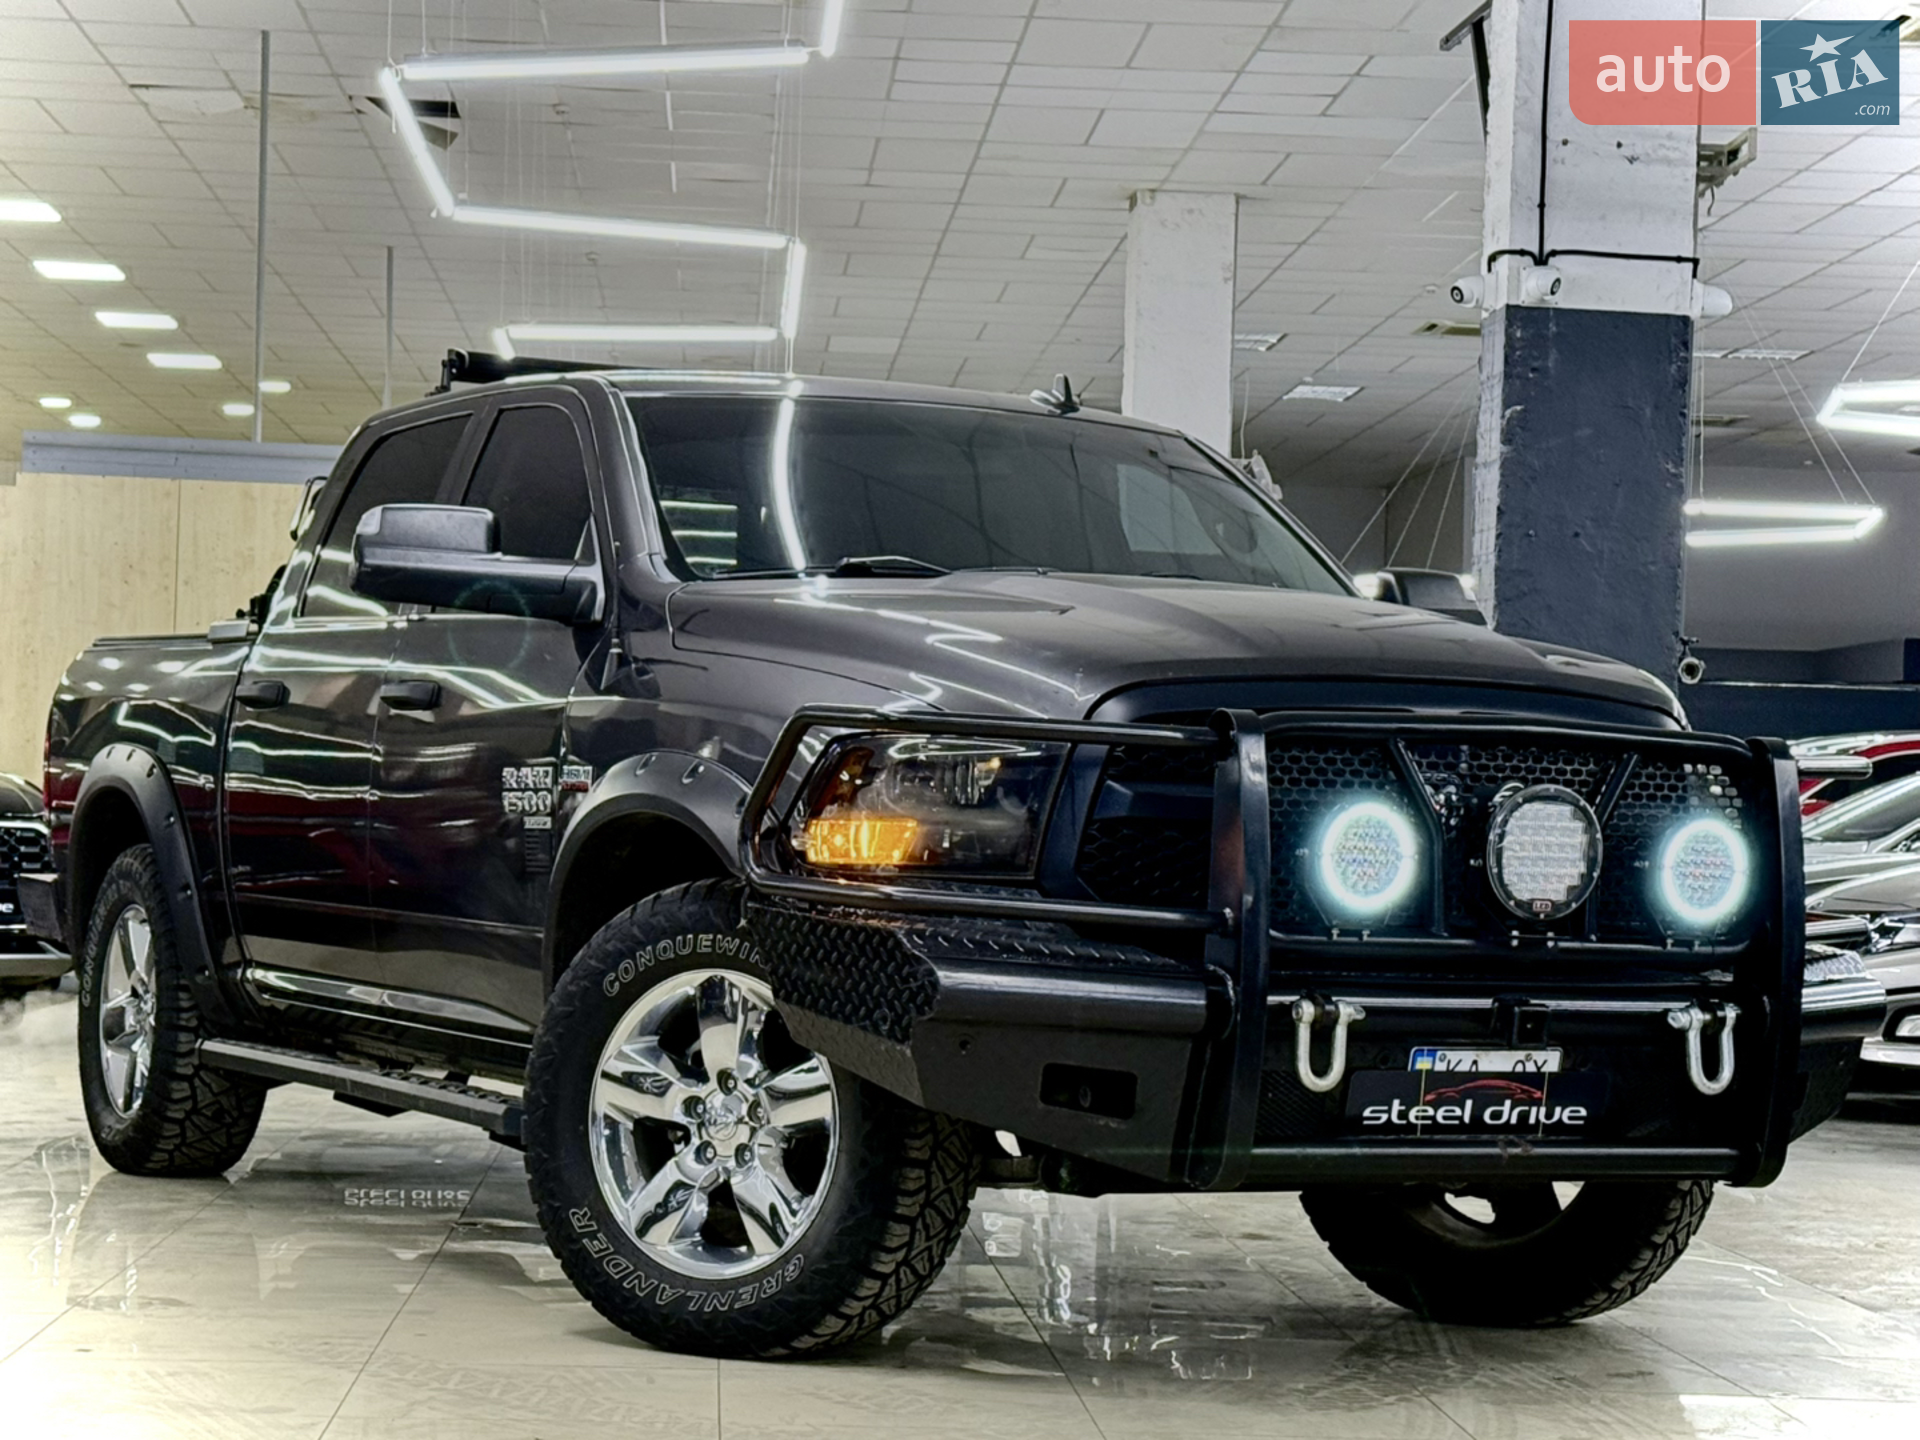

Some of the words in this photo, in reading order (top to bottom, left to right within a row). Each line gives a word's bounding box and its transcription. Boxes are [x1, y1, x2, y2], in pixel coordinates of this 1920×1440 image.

[1362, 1099, 1473, 1125] steel
[1483, 1099, 1587, 1125] drive
[569, 1207, 805, 1312] GRENLANDER
